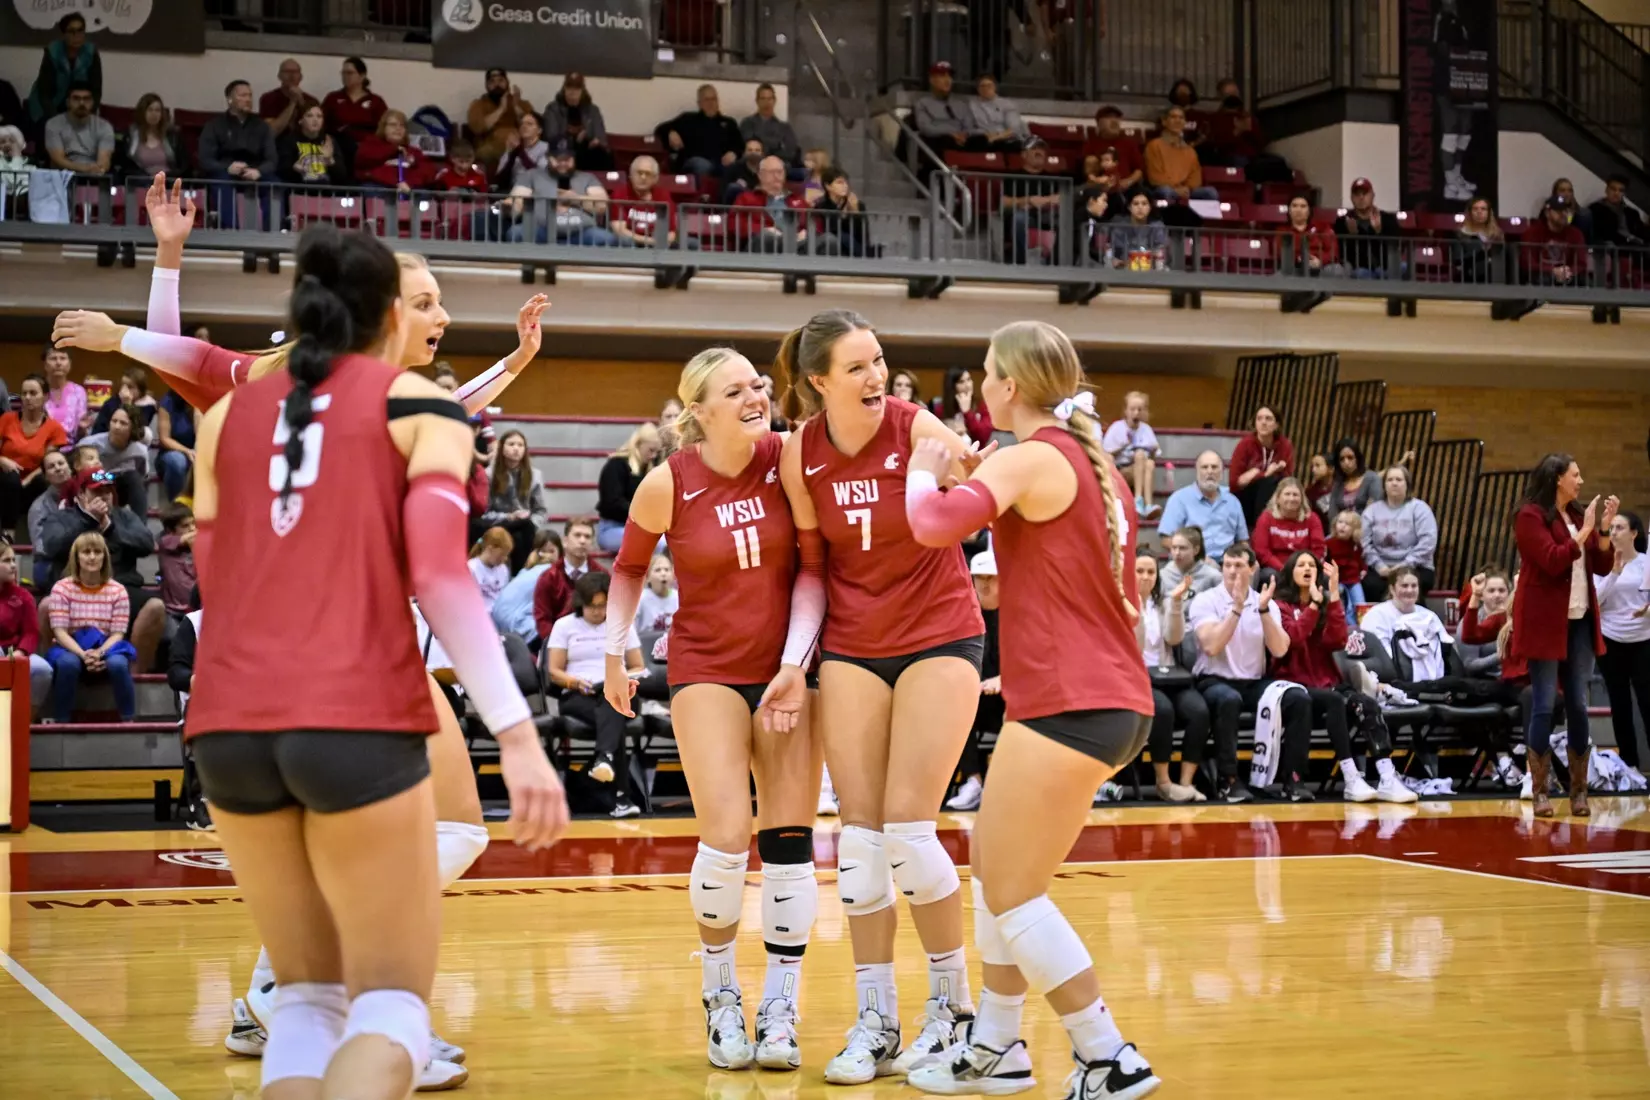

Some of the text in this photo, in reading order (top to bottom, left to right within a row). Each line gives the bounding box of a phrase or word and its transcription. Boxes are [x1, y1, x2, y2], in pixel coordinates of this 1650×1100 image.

[488, 4, 643, 30] Gesa Credit Union
[268, 393, 332, 492] 5
[832, 479, 880, 506] WSU
[714, 496, 766, 528] WSU
[844, 508, 872, 551] 7
[731, 525, 761, 570] 11
[27, 897, 244, 910] Mar
